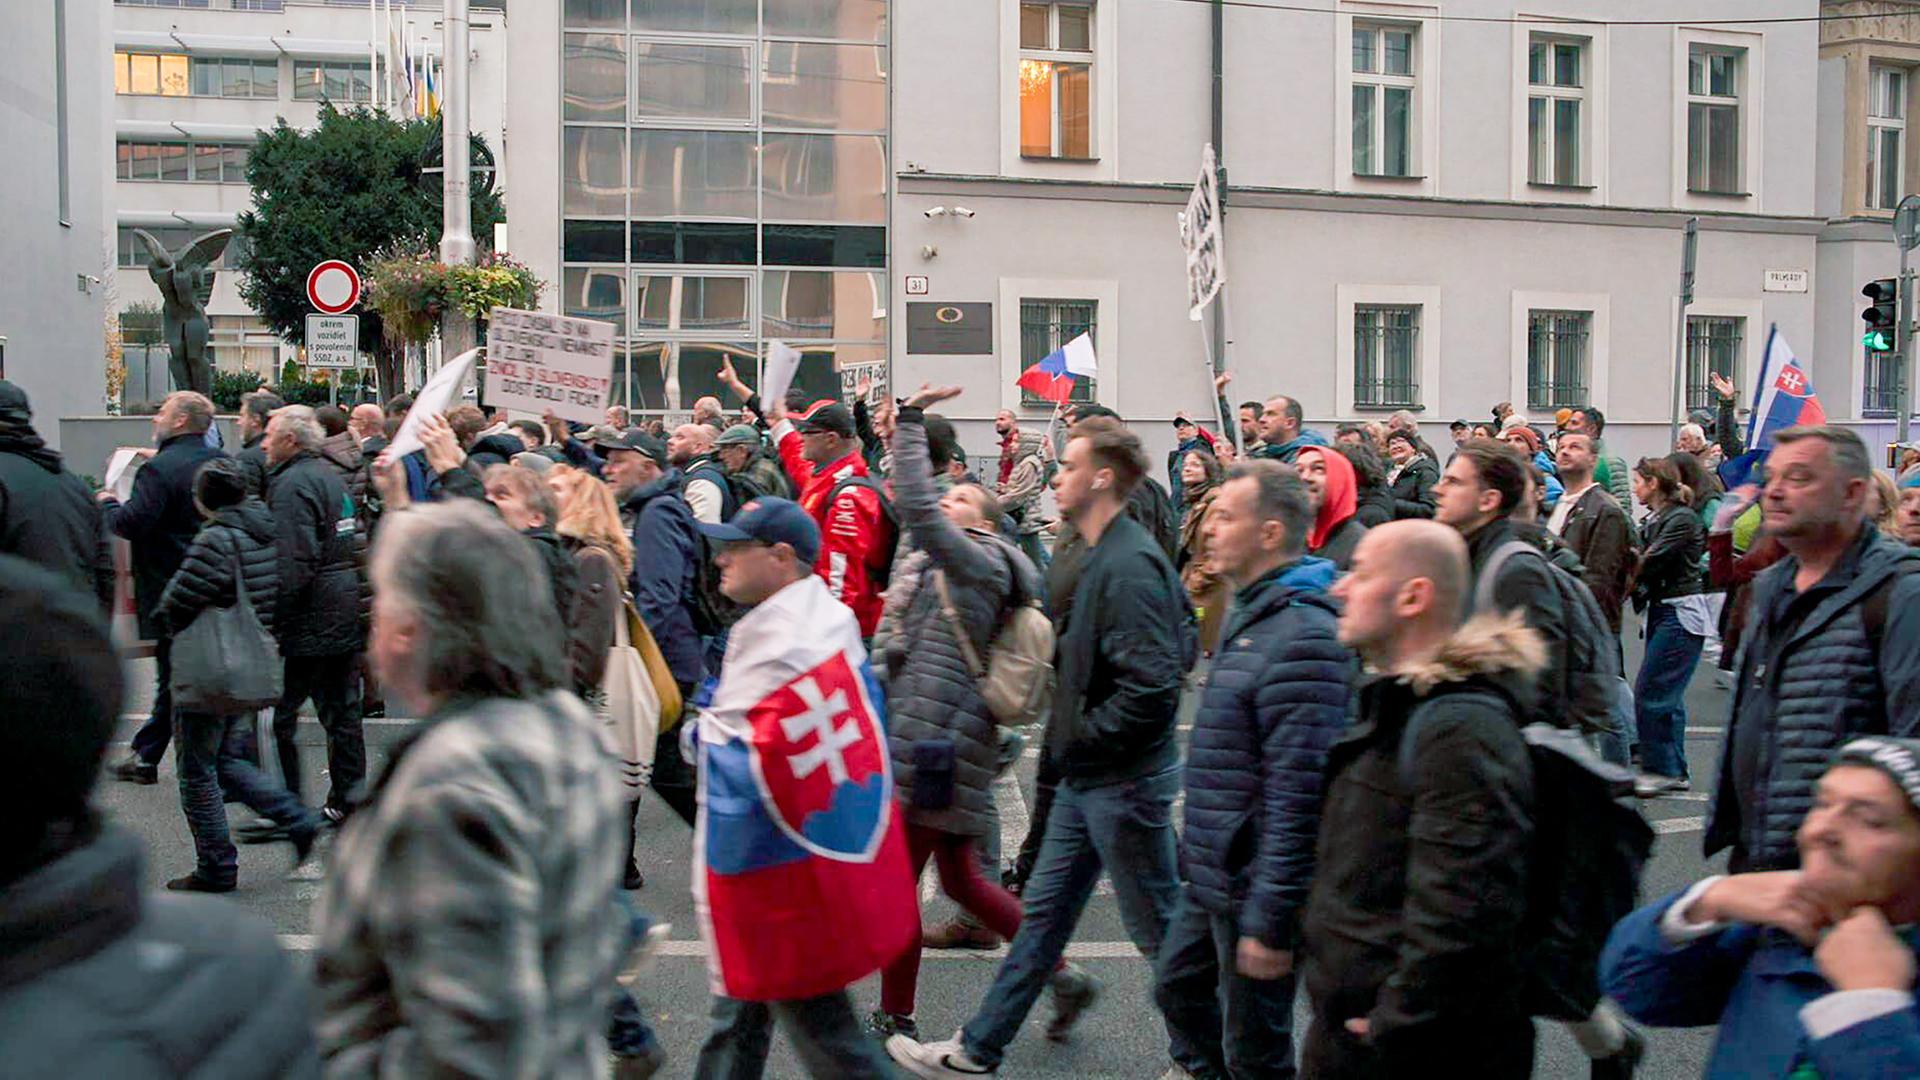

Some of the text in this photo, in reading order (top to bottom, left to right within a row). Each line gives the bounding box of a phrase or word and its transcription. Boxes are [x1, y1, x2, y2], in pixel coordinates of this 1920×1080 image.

[912, 280, 922, 290] 31
[320, 320, 344, 328] okrem
[317, 331, 347, 340] vozidiel
